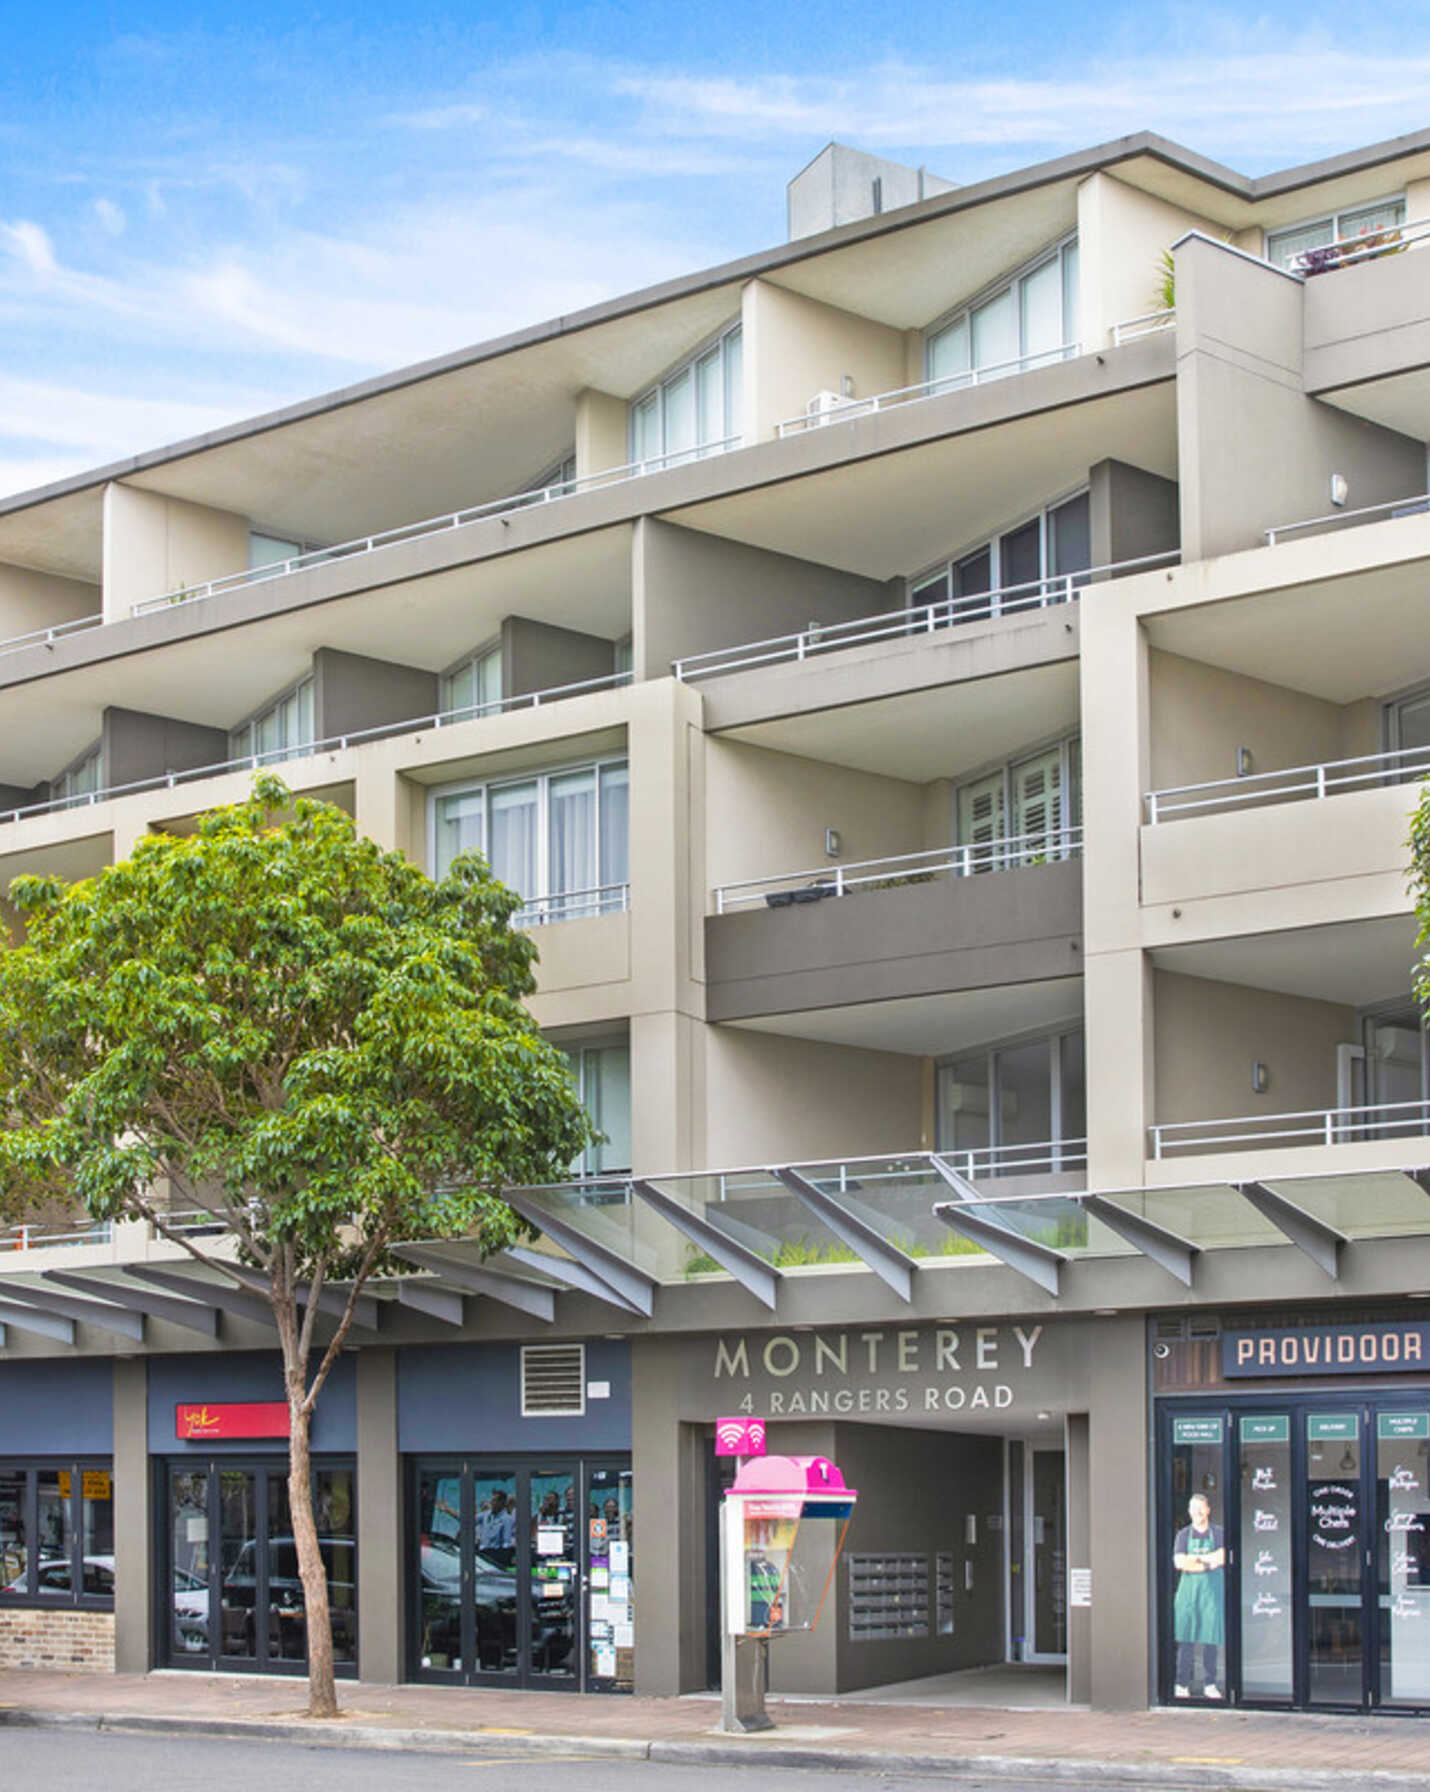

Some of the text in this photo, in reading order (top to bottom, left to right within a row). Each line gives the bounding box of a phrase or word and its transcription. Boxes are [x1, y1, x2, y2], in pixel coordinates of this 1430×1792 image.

[713, 1325, 1043, 1378] MONTEREY
[1237, 1332, 1422, 1366] PROVIDOOR
[739, 1384, 1014, 1414] 4 RANGERS ROAD
[1311, 1503, 1357, 1520] Multiple
[1319, 1516, 1350, 1529] Chefs
